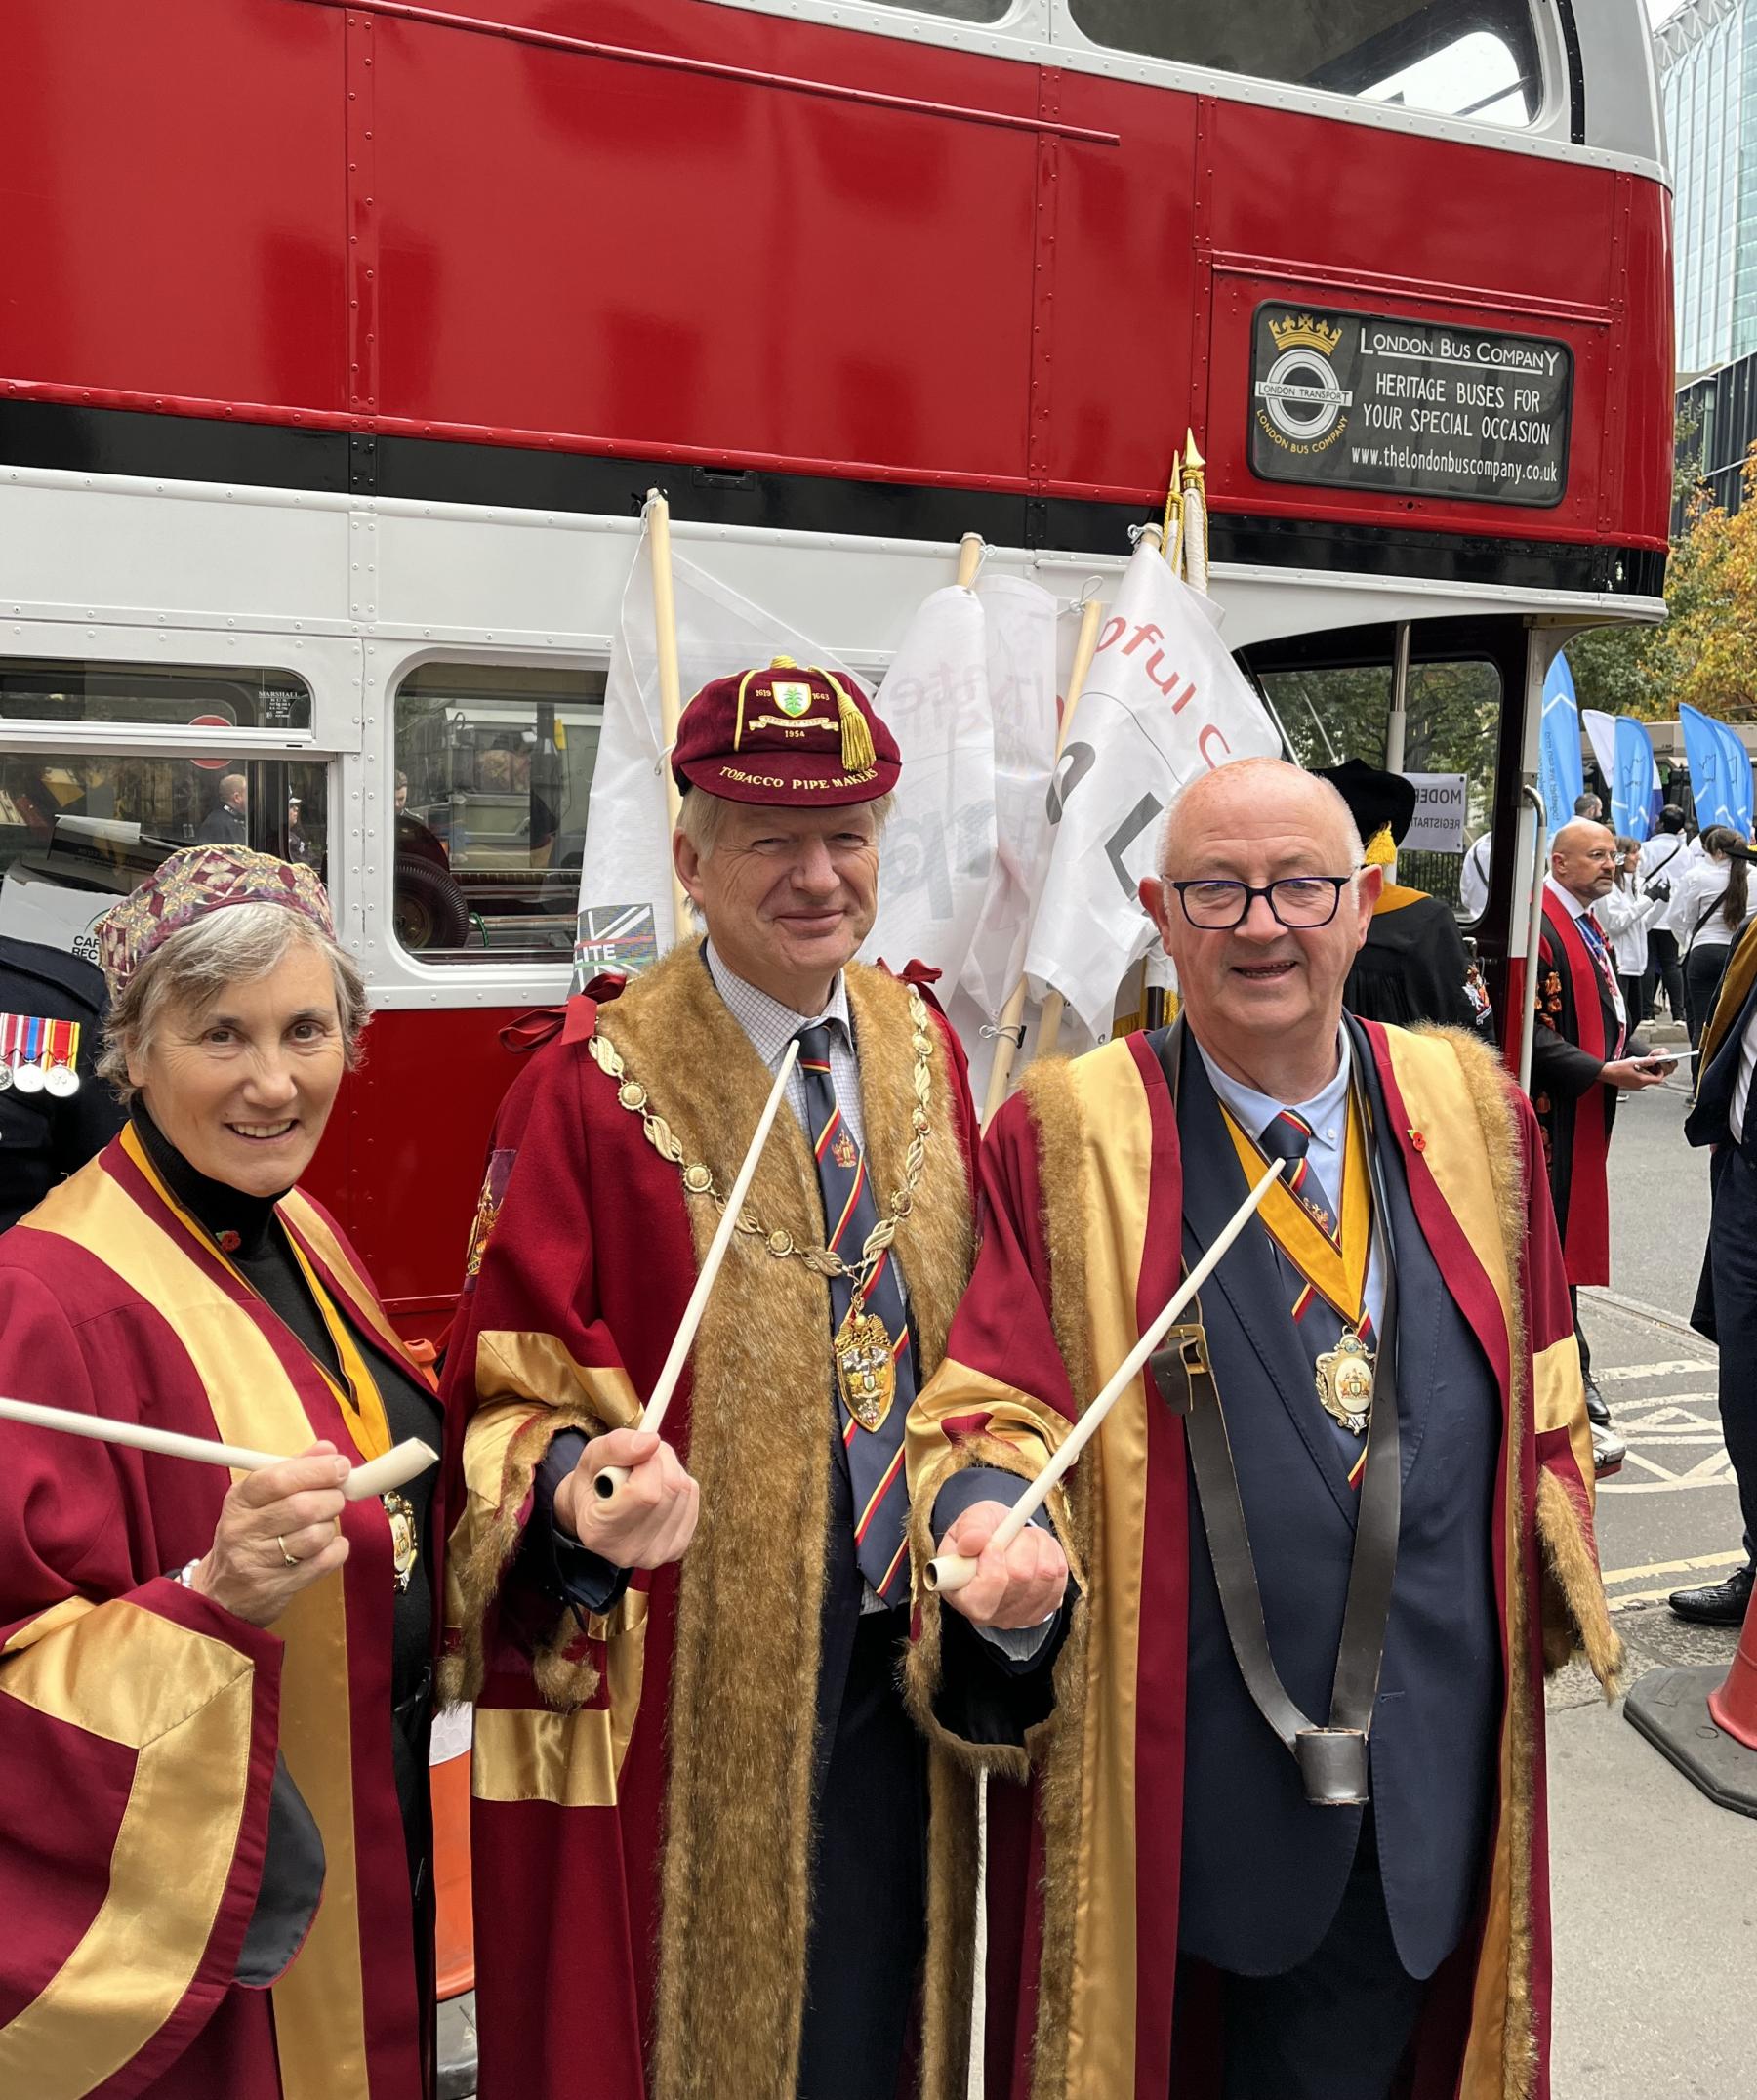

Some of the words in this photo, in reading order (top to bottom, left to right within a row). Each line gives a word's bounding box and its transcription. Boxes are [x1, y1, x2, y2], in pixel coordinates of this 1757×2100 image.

[1361, 327, 1433, 355] LONDON
[1440, 337, 1471, 360] BUS
[1476, 342, 1560, 377] COMPANY
[1259, 382, 1296, 396] LONDON
[1299, 388, 1350, 404] TRANSPORT
[1375, 372, 1446, 402] HERITAGE
[1456, 382, 1505, 409] BUSES
[1514, 389, 1540, 413] FOR
[1256, 408, 1289, 449] LONDON
[1290, 443, 1309, 455] BUS
[1311, 415, 1349, 453] COMPANY
[1363, 402, 1403, 431] YOUR
[1410, 408, 1473, 437] SPECIAL
[1481, 416, 1551, 445] OCCASION
[1350, 444, 1558, 485] www.thelondonbuscompany.co.uk
[784, 730, 806, 739] 1954
[719, 766, 785, 788] TOBACCO
[792, 779, 830, 790] PIPE
[832, 768, 878, 788] MAKERS
